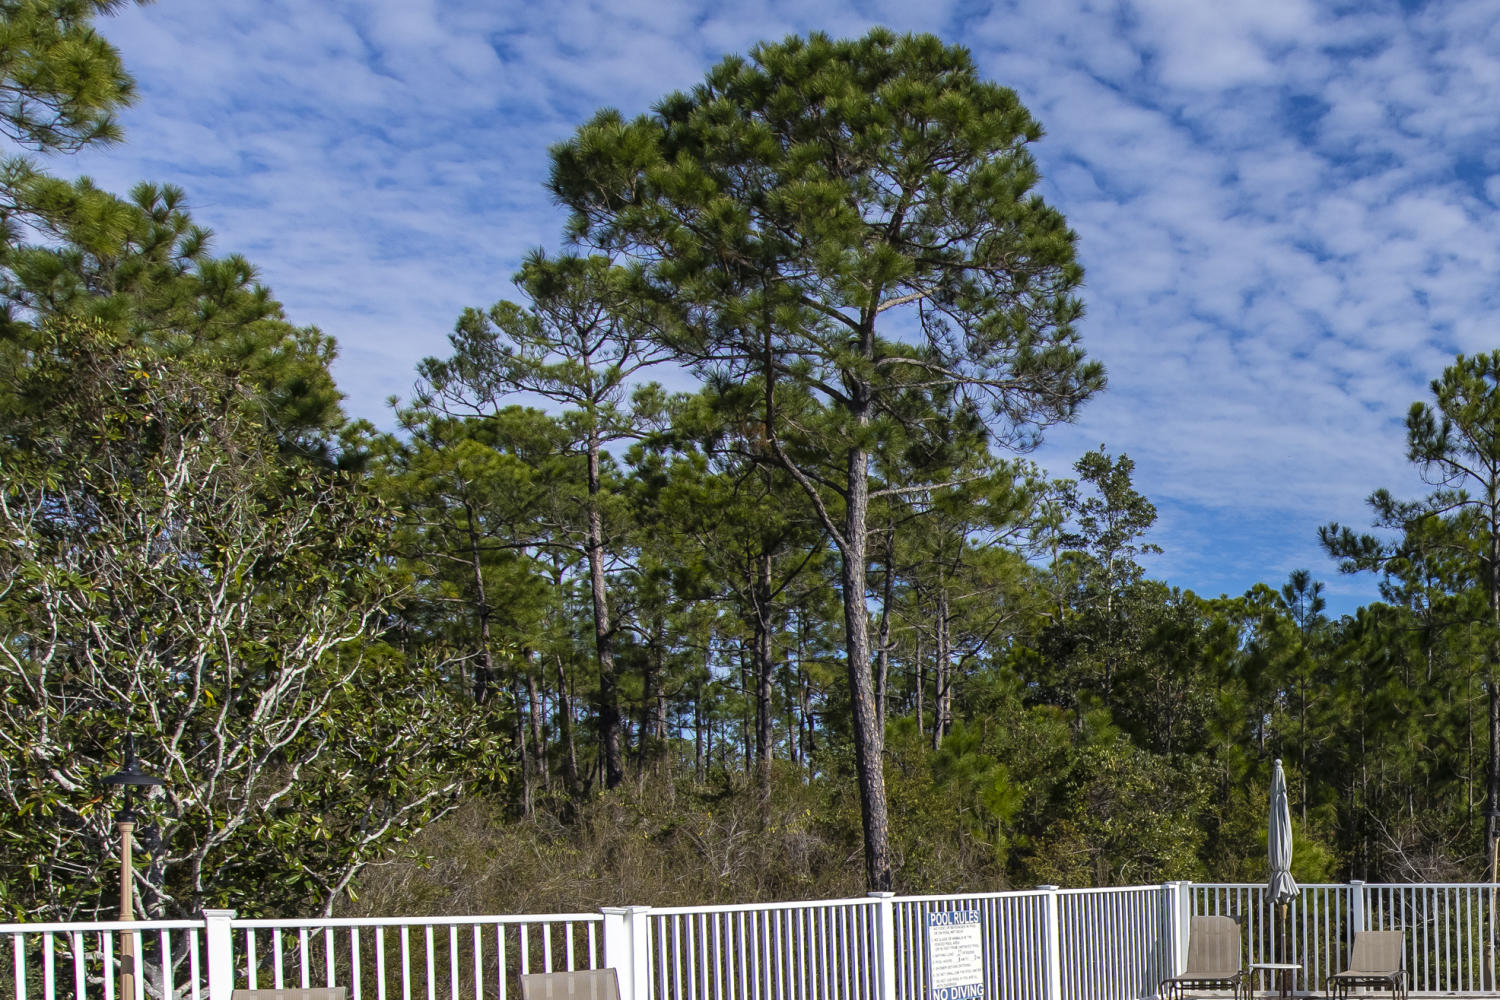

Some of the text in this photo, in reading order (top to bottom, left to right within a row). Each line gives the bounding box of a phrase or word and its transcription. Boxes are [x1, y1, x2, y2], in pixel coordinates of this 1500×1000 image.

[931, 910, 979, 926] POOL RULES
[951, 983, 984, 1000] DIVING
